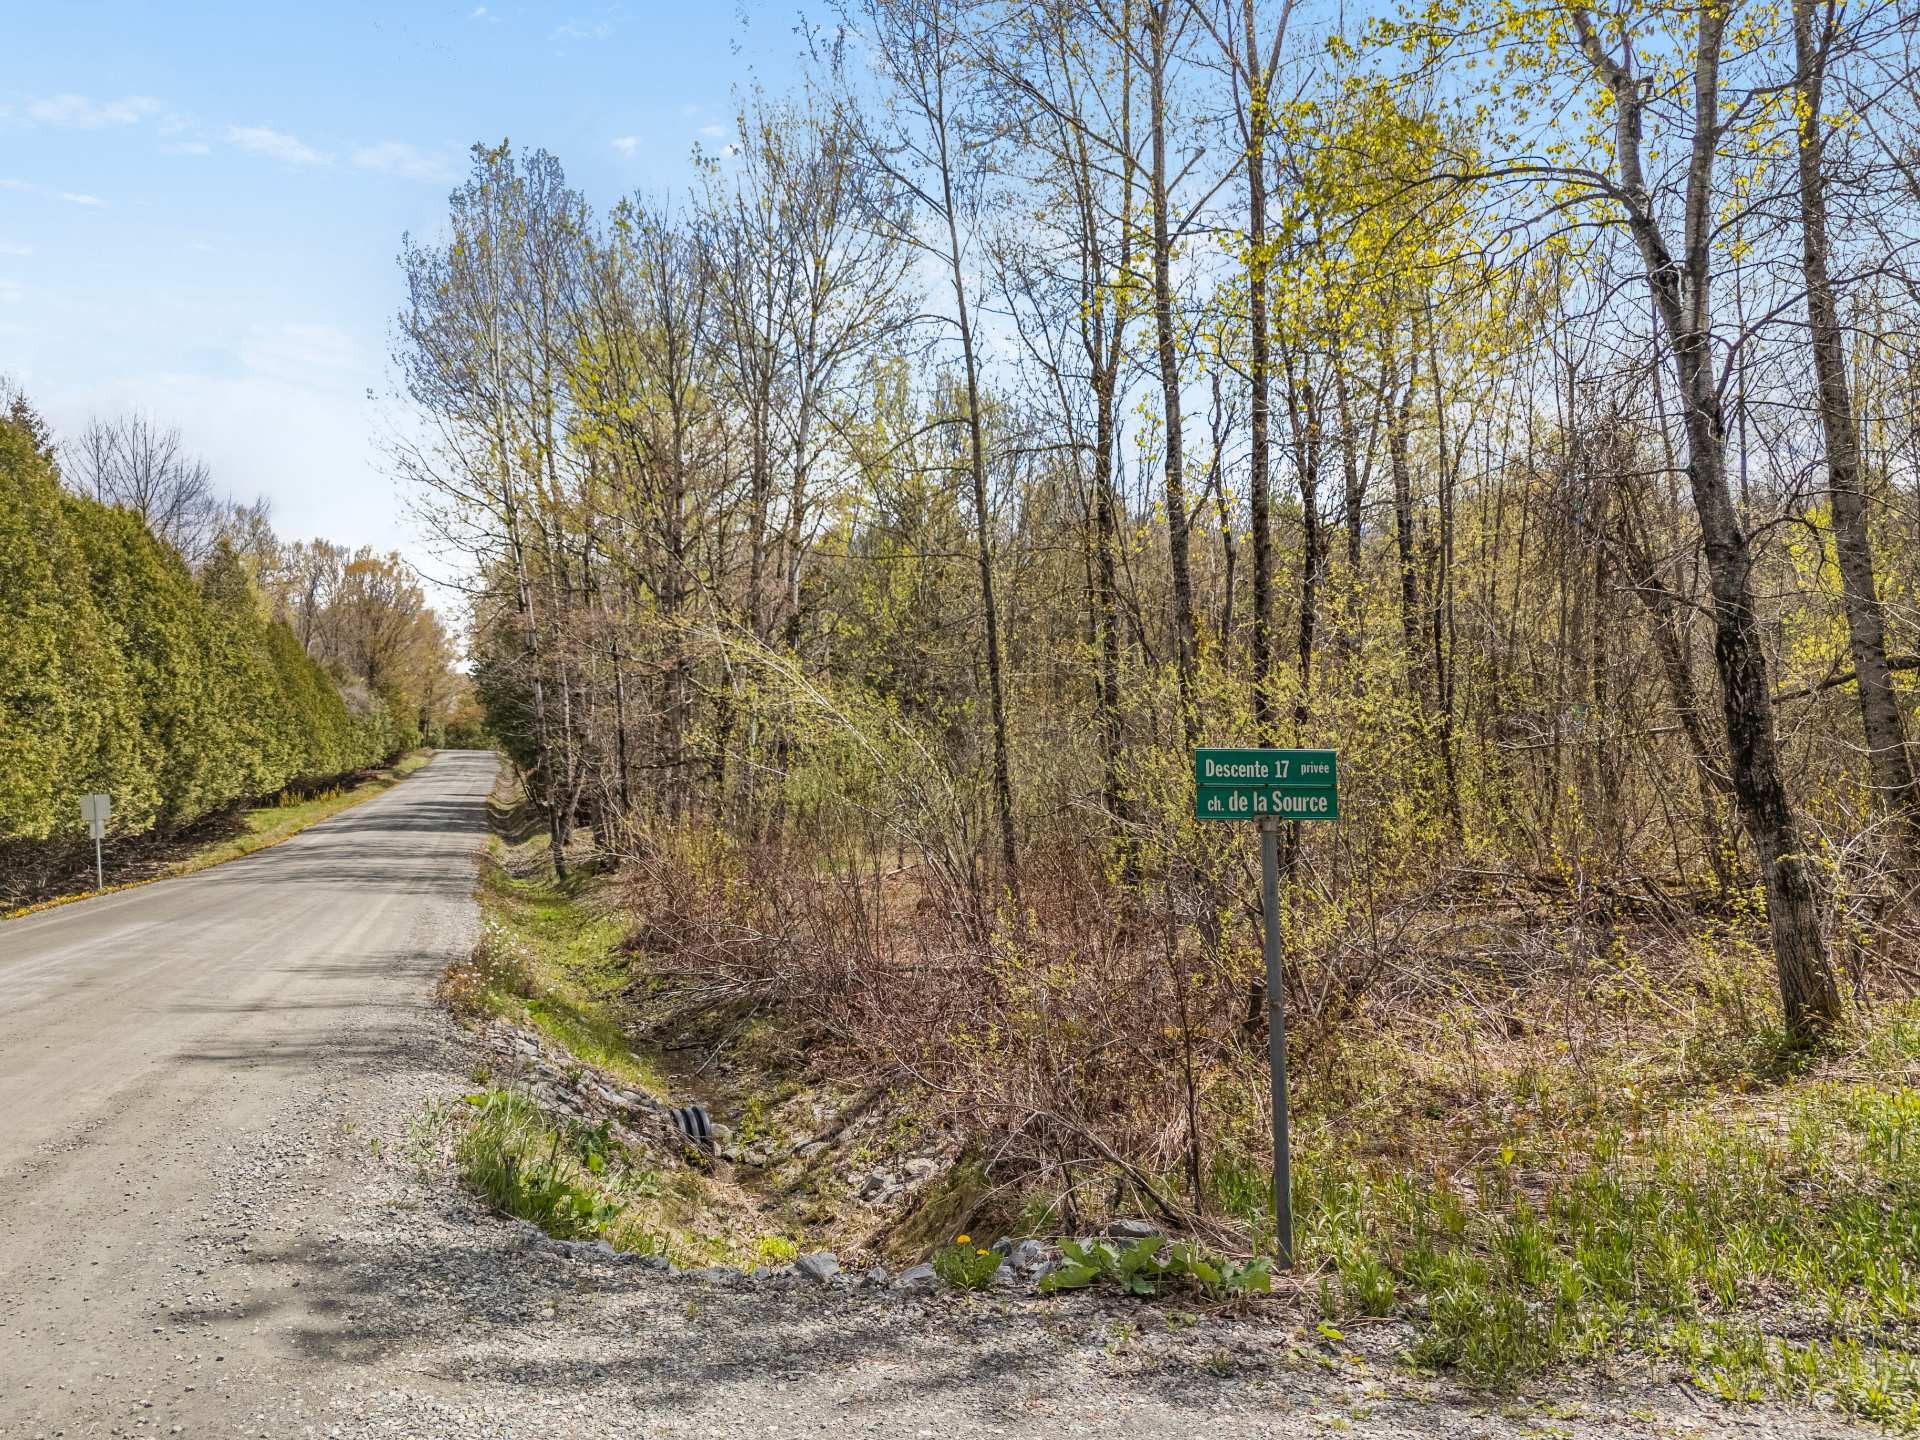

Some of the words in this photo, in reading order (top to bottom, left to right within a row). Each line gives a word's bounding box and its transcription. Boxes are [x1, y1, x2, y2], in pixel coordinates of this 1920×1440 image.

[1205, 759, 1269, 778] Descente
[1275, 760, 1290, 778] 17
[1300, 761, 1330, 776] privée
[1207, 795, 1225, 811] ch.
[1229, 790, 1248, 812] de
[1253, 791, 1268, 812] la
[1272, 790, 1328, 812] Source
